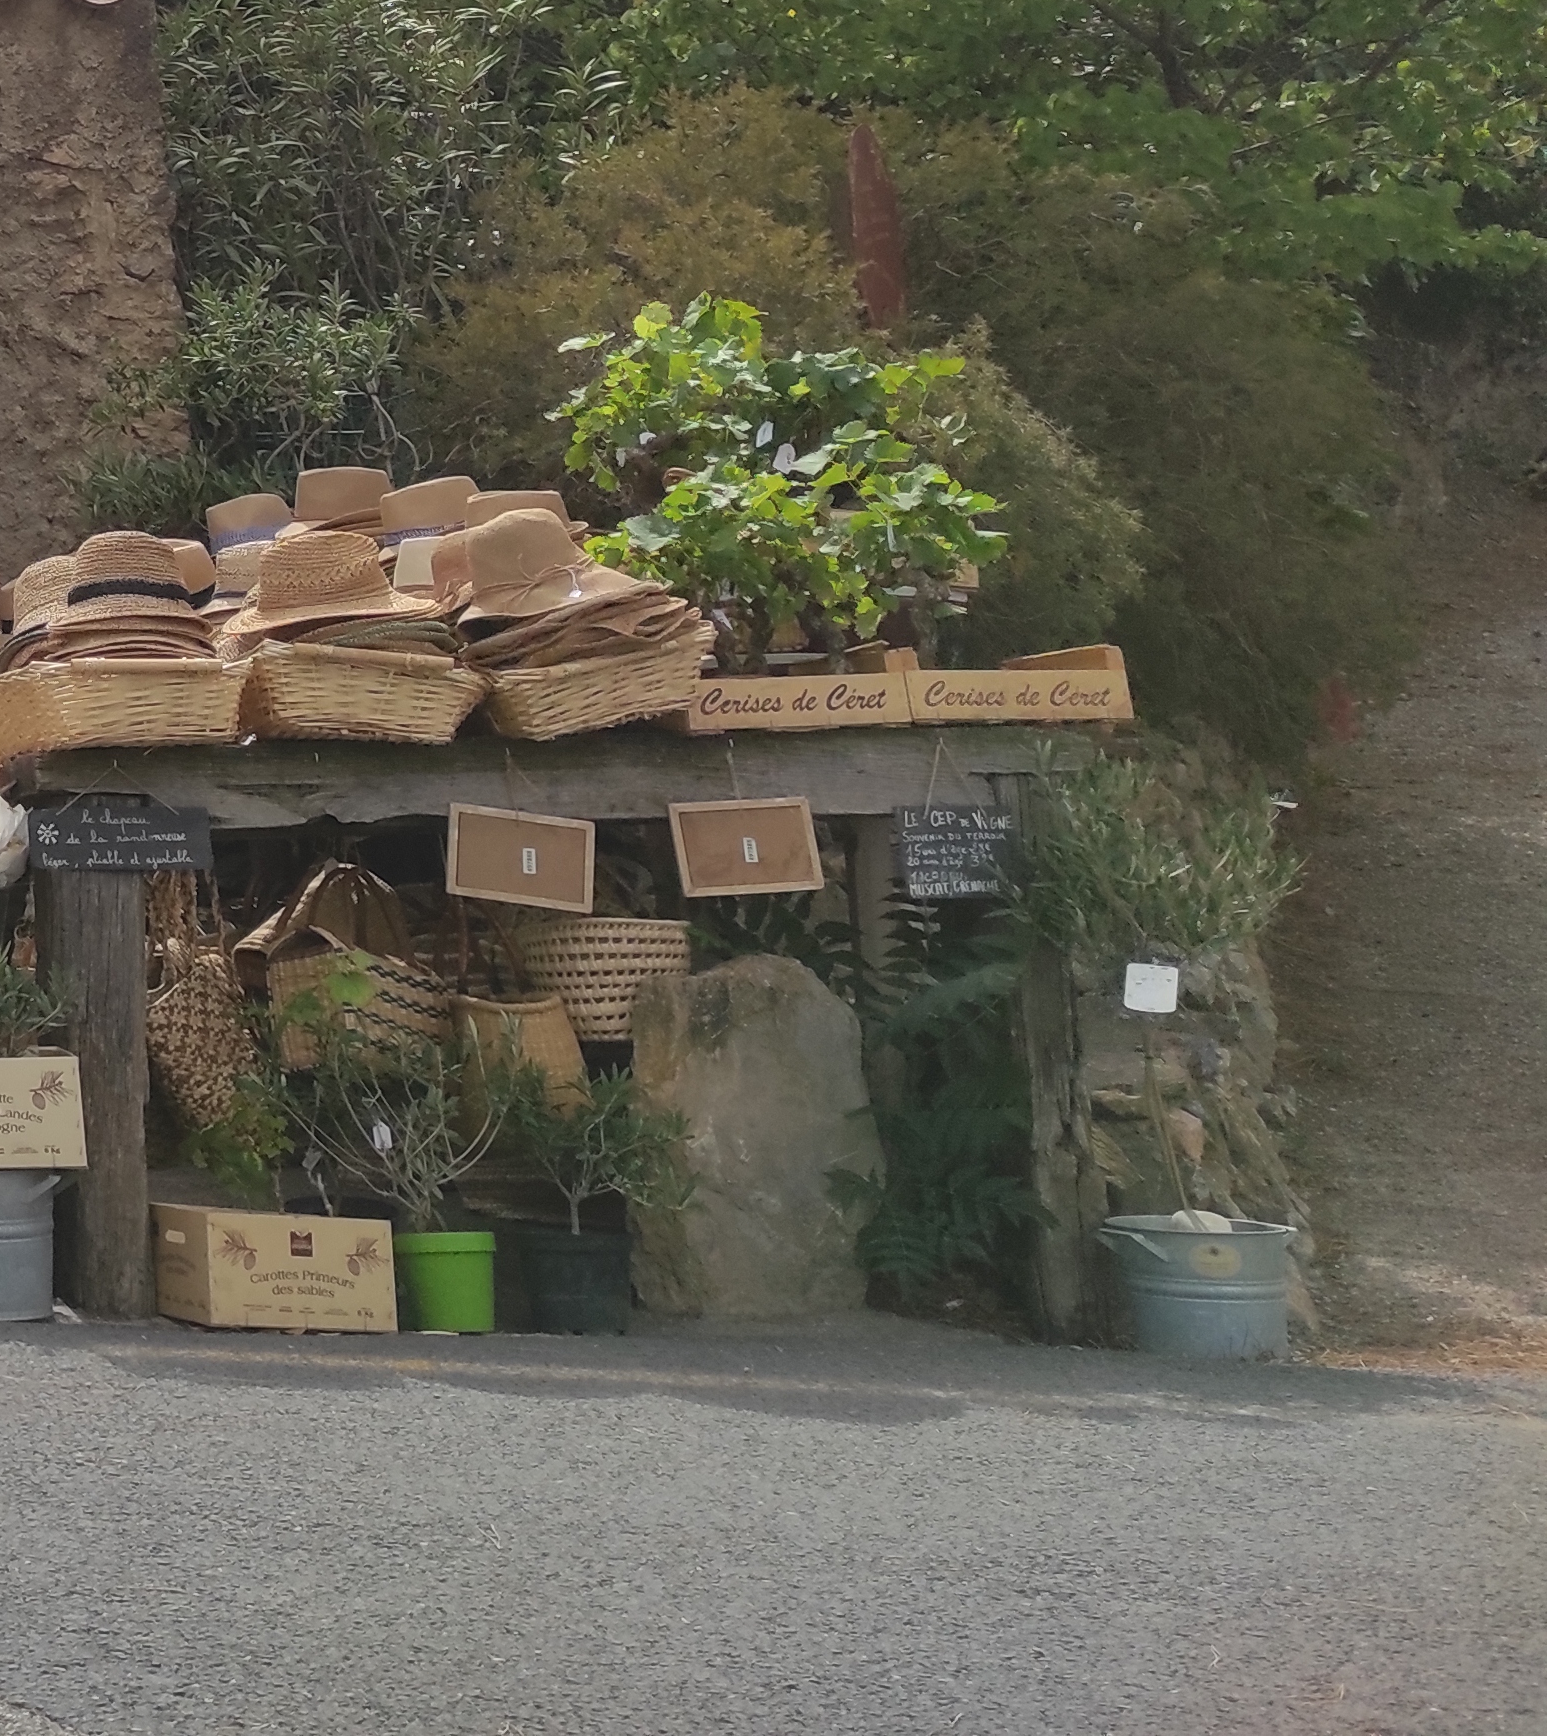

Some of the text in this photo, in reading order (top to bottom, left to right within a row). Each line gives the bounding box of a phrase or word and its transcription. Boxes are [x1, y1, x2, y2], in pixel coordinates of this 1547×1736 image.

[700, 683, 888, 716] Cerises de Céret
[923, 679, 1007, 708] Cerises
[1015, 683, 1041, 707] de
[99, 808, 151, 835] chapeau
[904, 810, 919, 828] LE
[930, 810, 957, 828] CEP
[65, 833, 82, 845] de
[90, 829, 108, 843] la
[947, 832, 962, 841] DU
[145, 849, 194, 869] ajustable
[907, 856, 920, 866] 20
[249, 1269, 356, 1290] Carottes Primeurs
[272, 1284, 335, 1299] des sables
